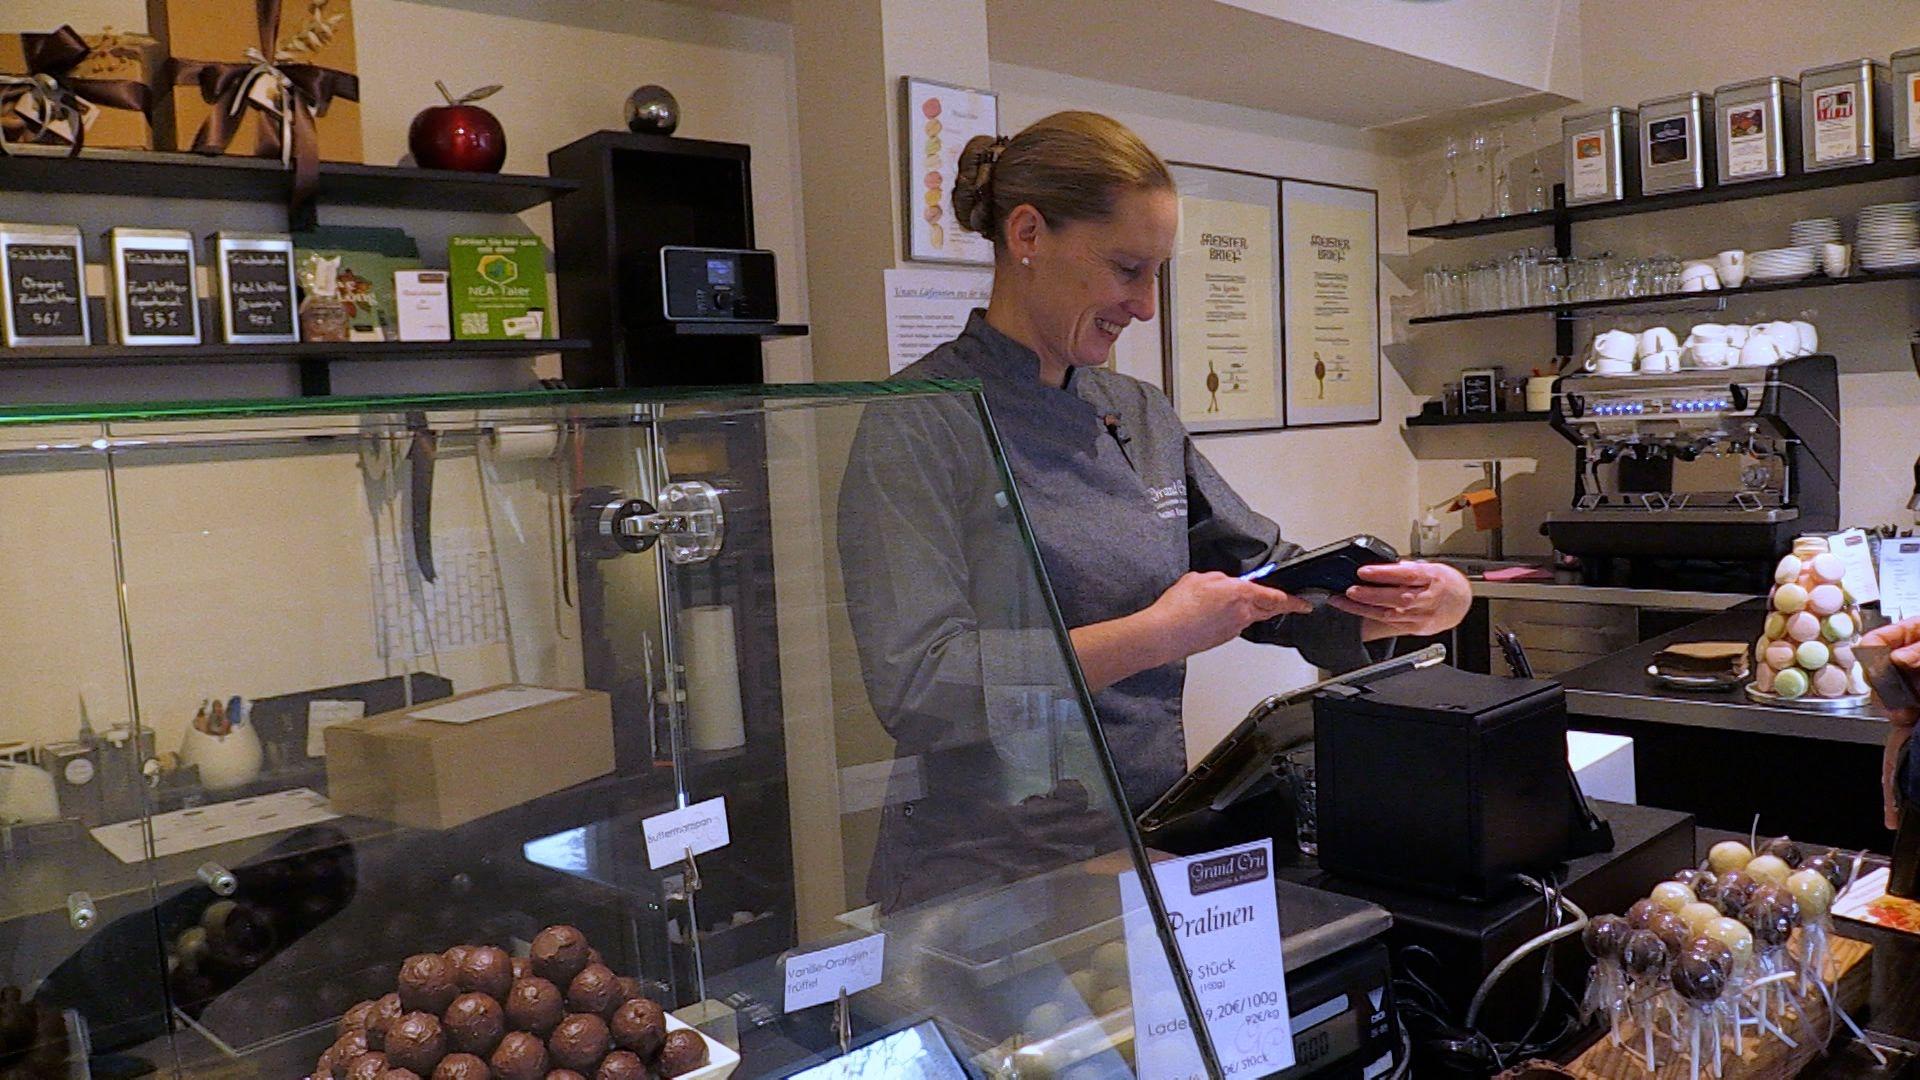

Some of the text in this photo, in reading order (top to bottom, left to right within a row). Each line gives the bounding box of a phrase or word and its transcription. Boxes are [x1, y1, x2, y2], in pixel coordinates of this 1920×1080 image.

[1190, 857, 1235, 883] Grand
[1236, 853, 1265, 871] Cru
[1167, 905, 1255, 938] Pralinen
[1198, 957, 1236, 980] Stück
[1147, 990, 1278, 1036] Lade 9,20€/100g
